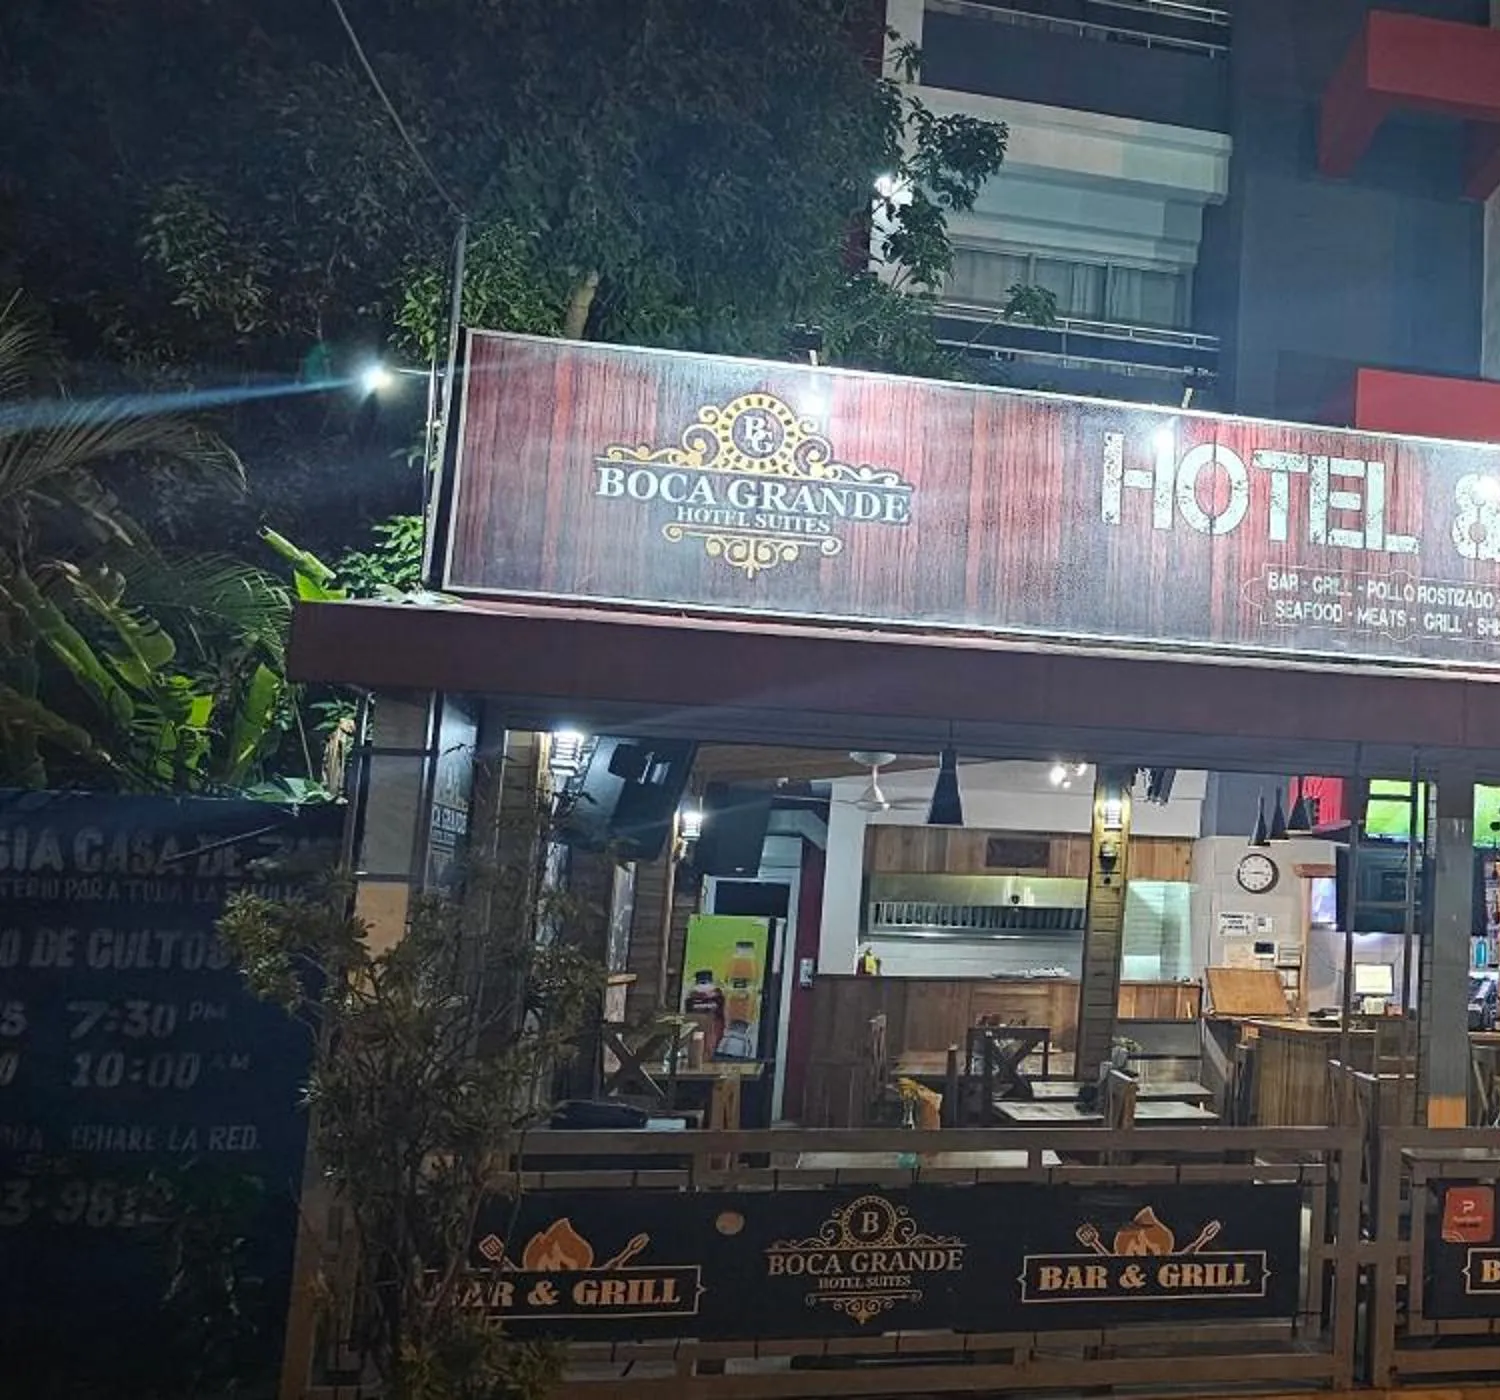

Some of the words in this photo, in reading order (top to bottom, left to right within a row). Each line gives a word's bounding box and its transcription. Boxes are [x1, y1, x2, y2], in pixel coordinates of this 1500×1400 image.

[596, 467, 716, 504] BOCA
[727, 480, 912, 523] GRANDE
[1101, 432, 1419, 554] HOTEL
[677, 505, 749, 527] HOTEL
[755, 510, 830, 534] SUITES
[1268, 572, 1298, 591] BAR
[1313, 576, 1352, 596] GRILL
[1367, 581, 1414, 602] POLLO
[1417, 585, 1493, 609] ROSTIZADO
[1276, 601, 1342, 622] SEAFOOD
[1357, 607, 1406, 627] MEATS
[1424, 613, 1462, 633] GRILL
[29, 927, 79, 967] DE
[66, 1000, 177, 1039] 7:30
[71, 1052, 200, 1088] 10:00
[168, 1123, 198, 1150] LA
[768, 1249, 842, 1276] BOCA
[850, 1247, 963, 1273] GRANDE
[1039, 1265, 1107, 1291] BAR
[1119, 1265, 1146, 1289] &
[1157, 1263, 1251, 1288] GRILL
[527, 1280, 560, 1307] &
[573, 1279, 680, 1306] GRILL
[818, 1276, 863, 1291] HOTEL
[865, 1274, 910, 1290] SUITES
